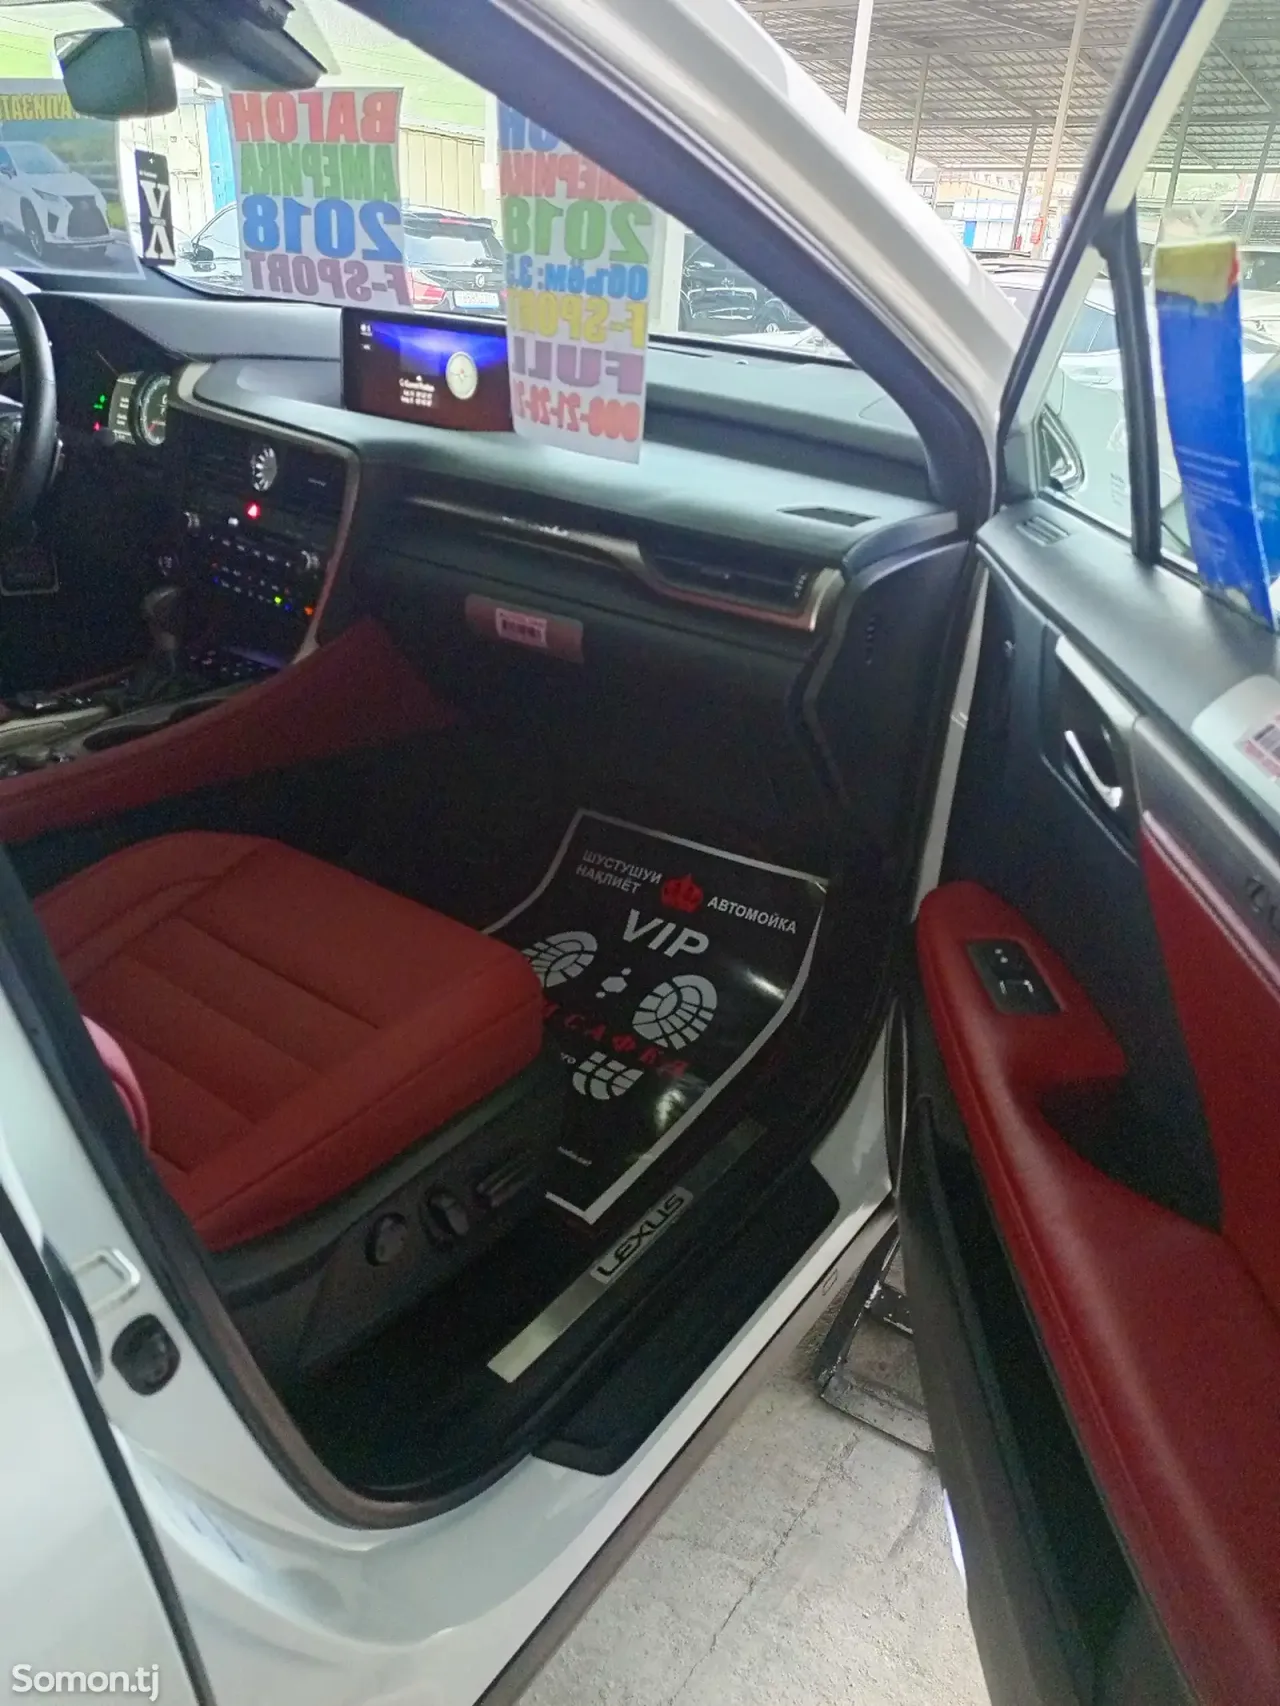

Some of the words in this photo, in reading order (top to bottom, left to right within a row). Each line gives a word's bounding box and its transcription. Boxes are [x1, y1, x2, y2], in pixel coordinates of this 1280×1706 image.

[622, 908, 710, 958] VIP
[707, 896, 798, 934] АВТОМОЙКА
[597, 1193, 684, 1276] LEXUS
